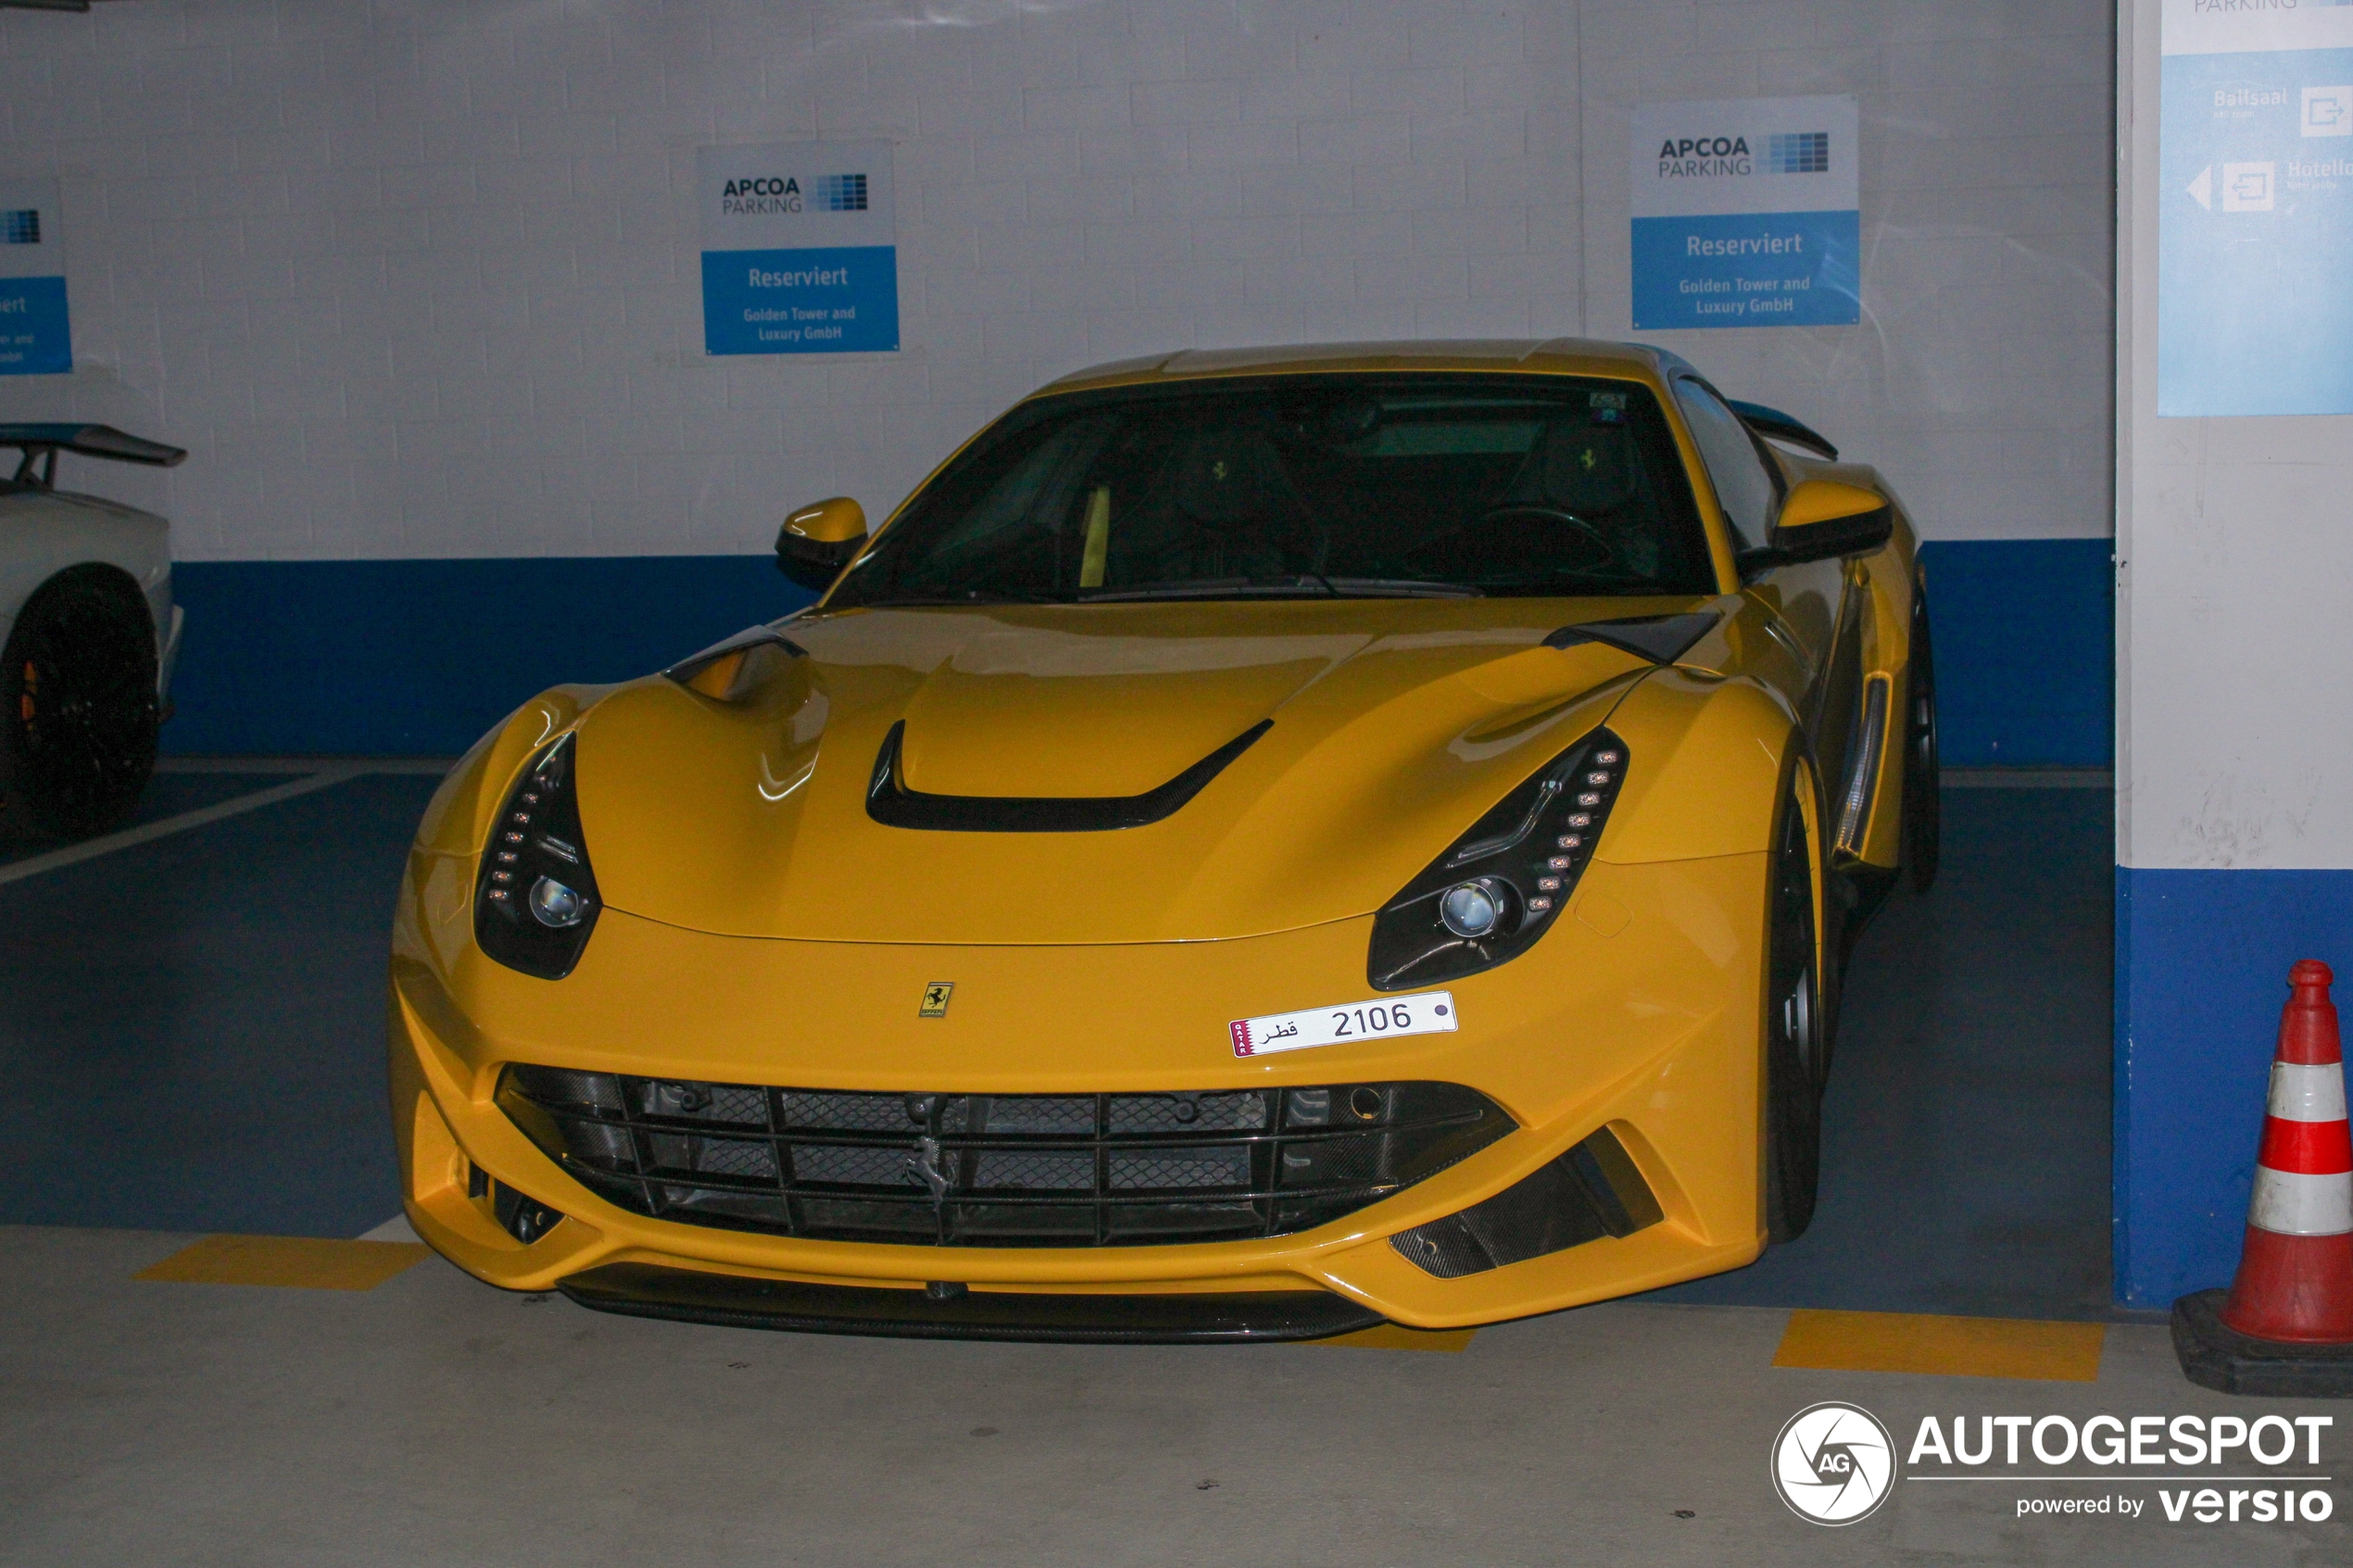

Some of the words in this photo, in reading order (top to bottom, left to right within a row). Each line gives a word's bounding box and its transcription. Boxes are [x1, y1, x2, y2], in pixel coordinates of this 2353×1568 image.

[2214, 87, 2288, 107] Ballsaal
[1659, 136, 1750, 158] APCOA
[1658, 158, 1751, 178] PARKING
[723, 177, 800, 196] APCOA
[723, 196, 801, 215] PARKING
[1687, 232, 1802, 257] Reserviert
[749, 266, 849, 287] Reserviert
[1680, 279, 1730, 294] Golden
[1735, 278, 1779, 293] Tower
[1783, 277, 1810, 291] and
[744, 307, 787, 322] Golden
[791, 307, 827, 320] Tower
[832, 306, 855, 320] and
[1696, 300, 1745, 316] Luxury
[1750, 297, 1793, 312] GmbH
[759, 327, 800, 342] Luxury
[804, 326, 842, 340] GmbH
[1331, 1003, 1412, 1036] 2106
[1235, 1023, 1247, 1053] QATAR
[1259, 1021, 1299, 1045] قطر
